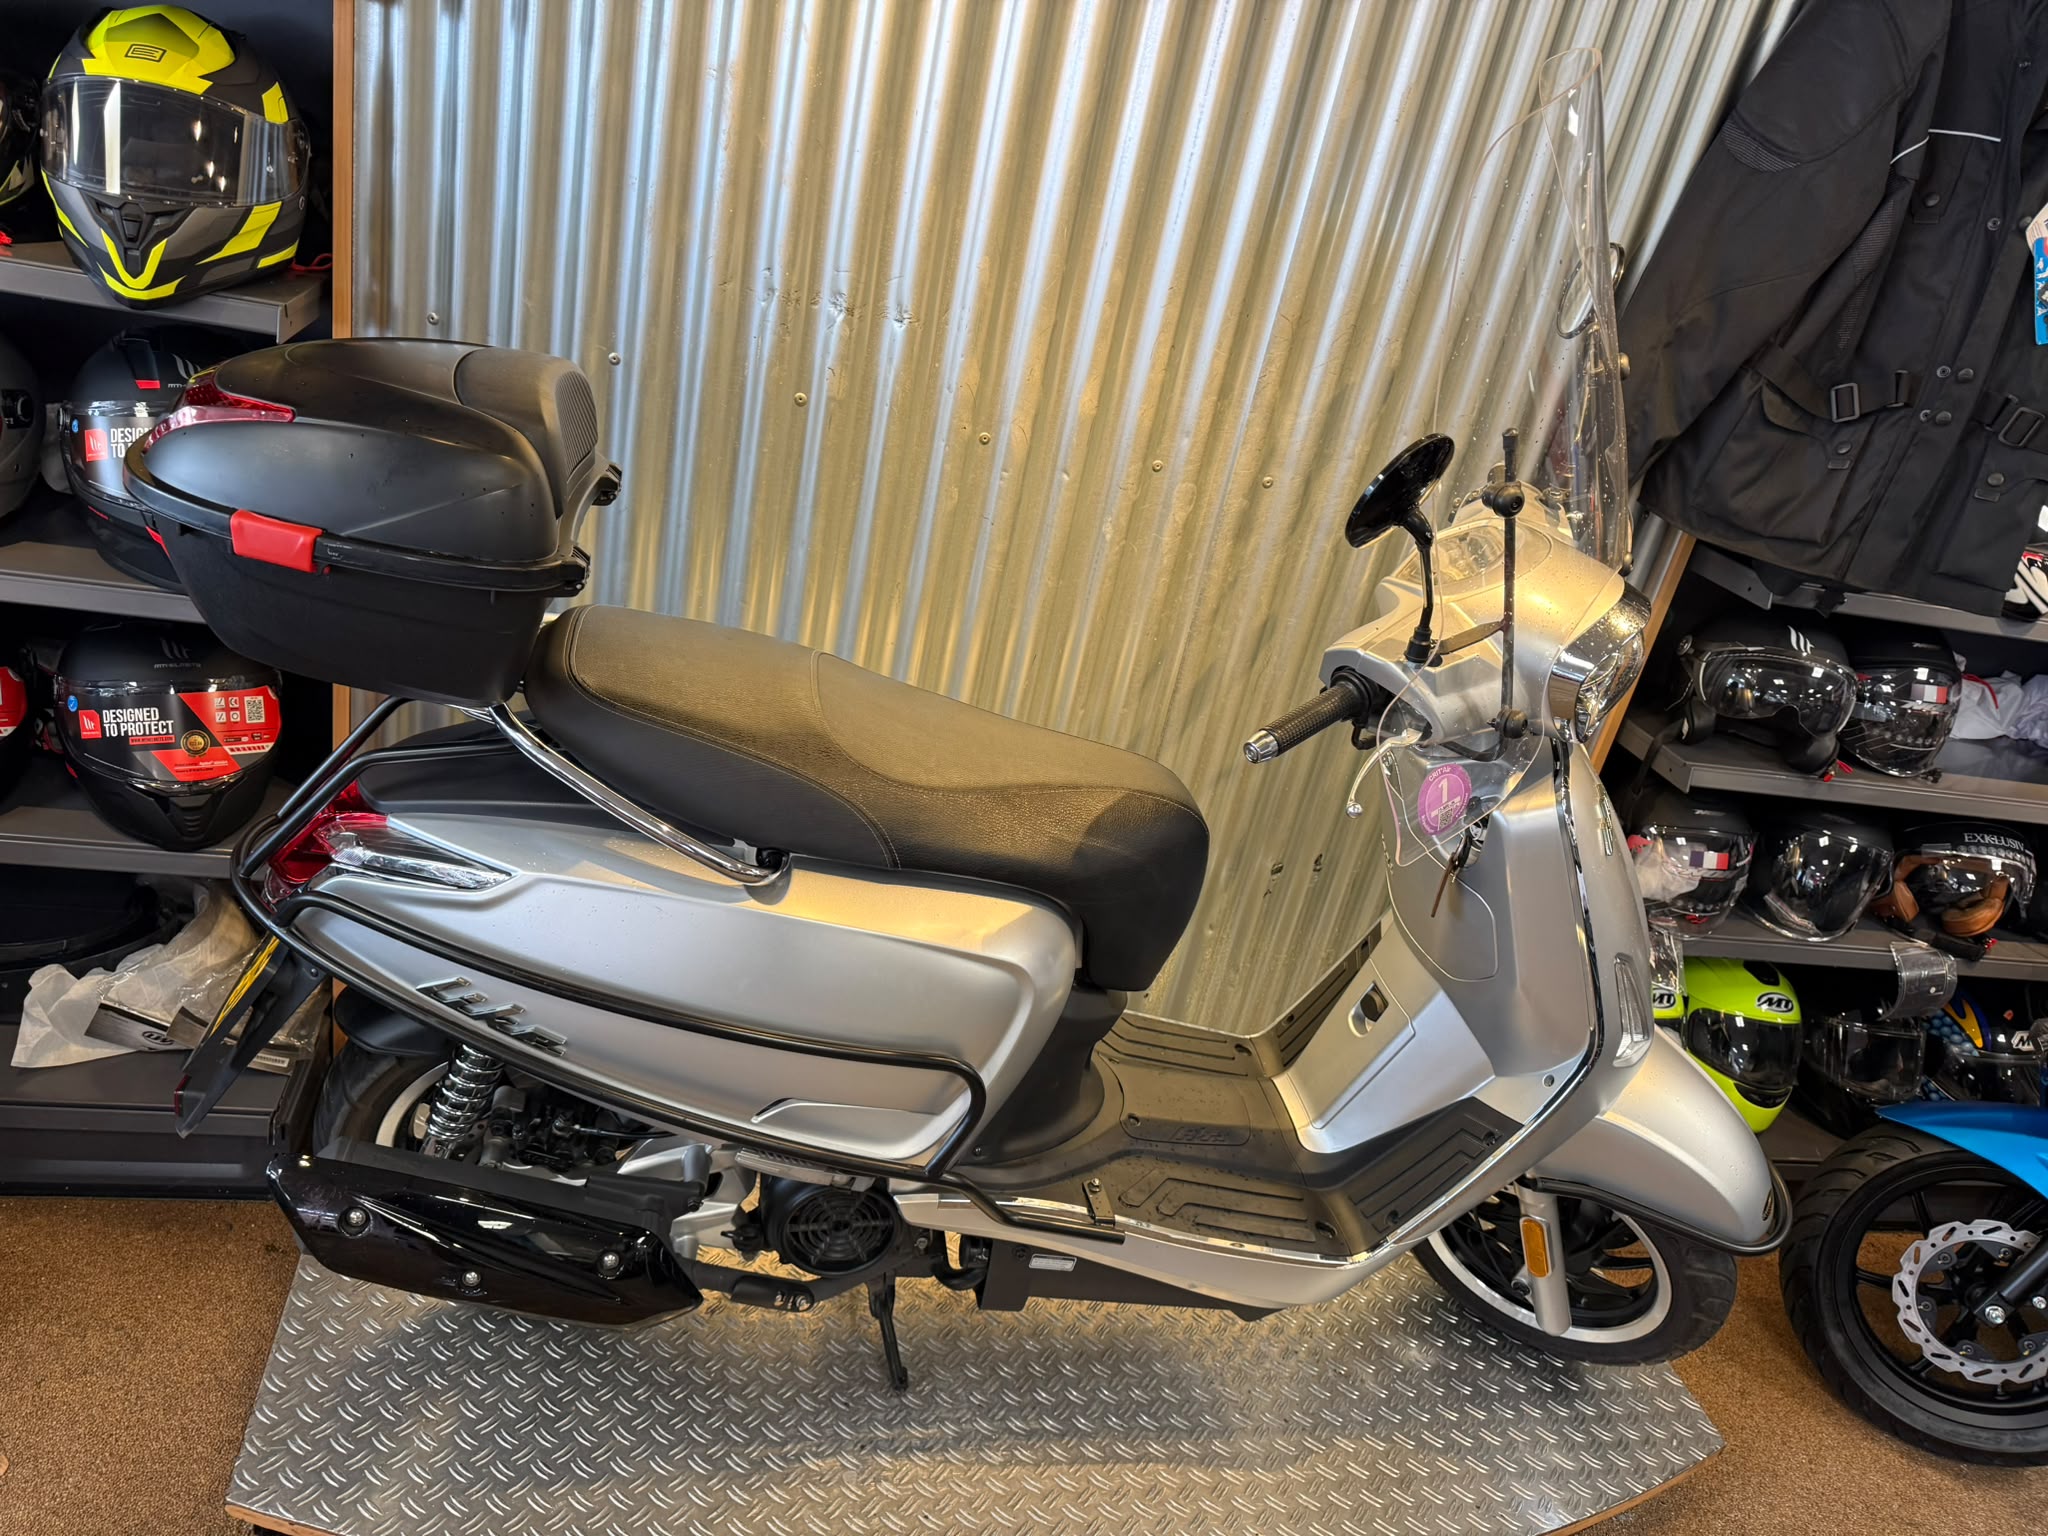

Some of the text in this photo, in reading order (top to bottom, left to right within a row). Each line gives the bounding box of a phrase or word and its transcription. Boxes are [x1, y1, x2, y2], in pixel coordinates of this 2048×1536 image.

[110, 443, 126, 458] TO
[102, 707, 160, 723] DESIGNED
[104, 720, 174, 738] TO PROTECT
